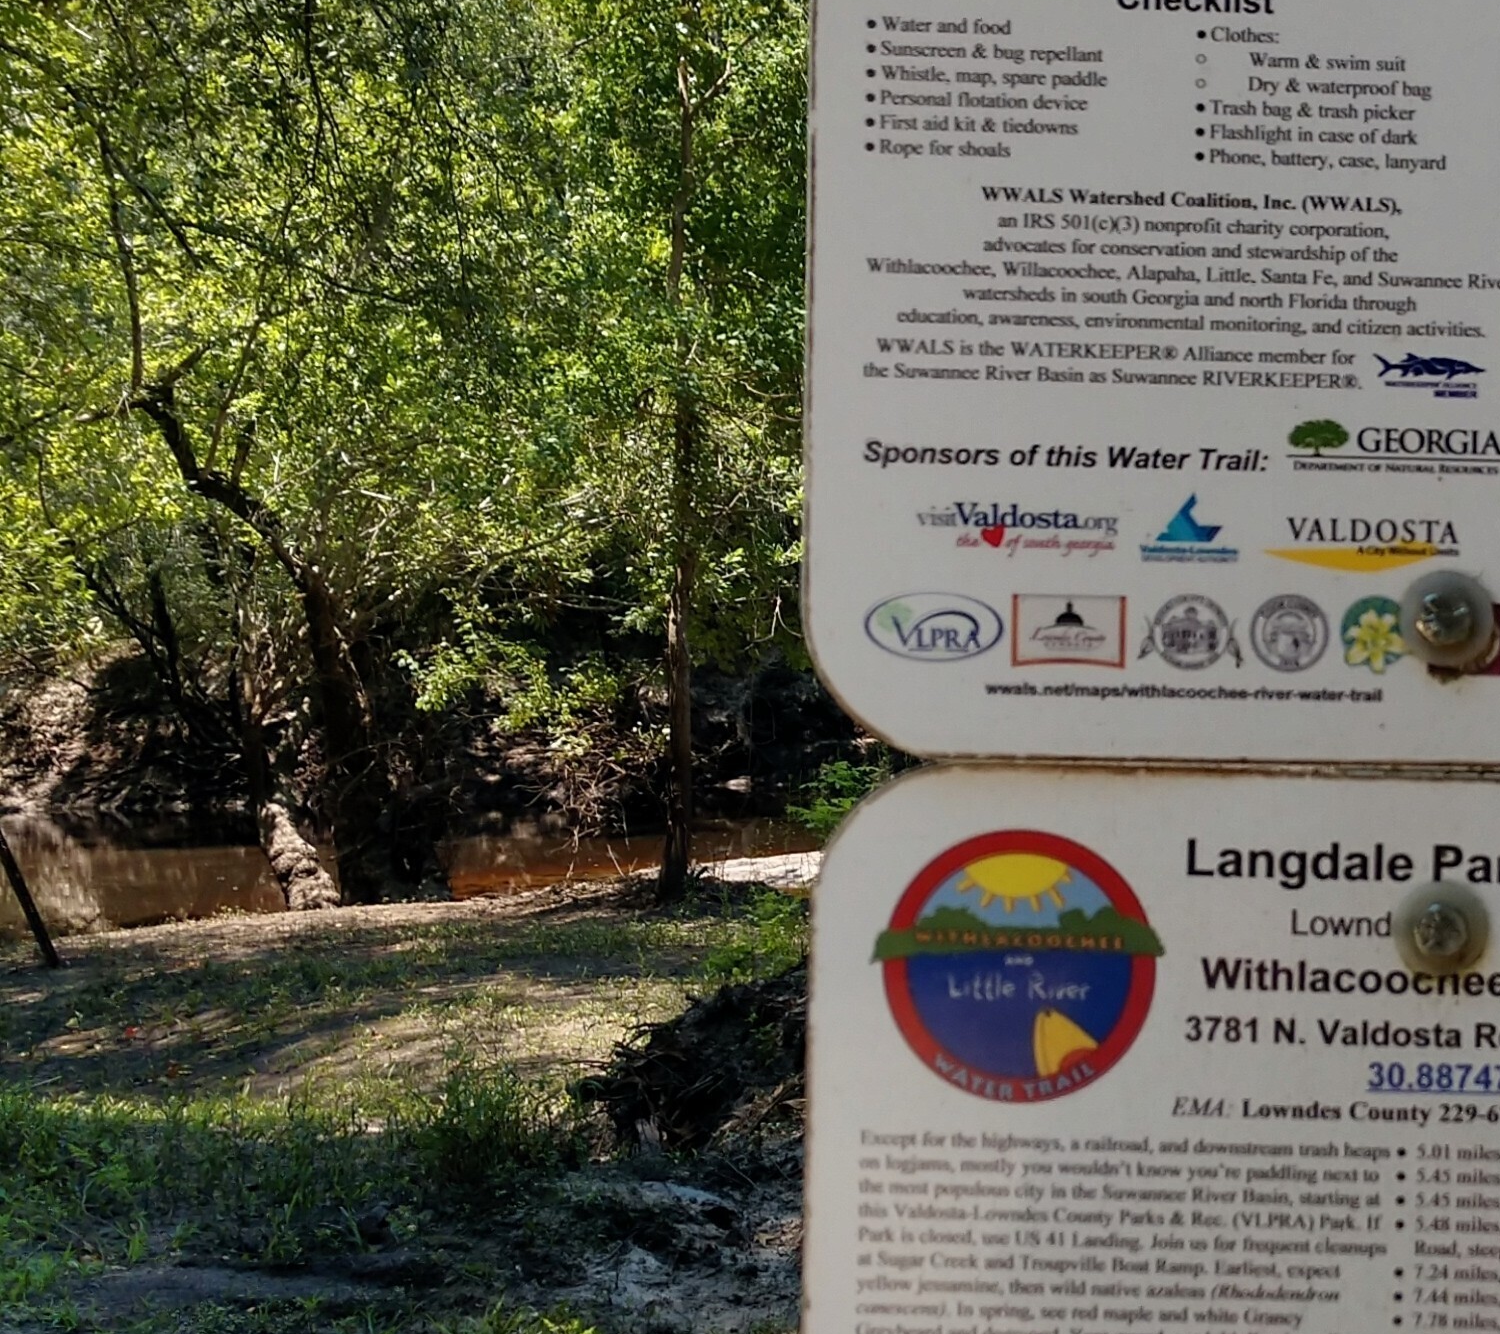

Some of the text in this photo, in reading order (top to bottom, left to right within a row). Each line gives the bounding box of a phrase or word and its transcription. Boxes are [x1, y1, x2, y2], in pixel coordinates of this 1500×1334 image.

[881, 15, 1012, 36] Water and food
[1211, 26, 1280, 44] Clothes:
[981, 186, 1403, 216] WWALS Watershed Coalition, Inc. (WWALS),
[863, 440, 1269, 472] Sponsors of this Water Trail:
[1286, 517, 1459, 545] VALDOSTA
[1186, 838, 1414, 890] Langdale
[915, 929, 1124, 950] WITHLACOOCHEE
[948, 971, 1091, 1001] Little River
[1185, 1015, 1258, 1044] 3781
[1273, 1017, 1306, 1045] N.
[1316, 1018, 1462, 1049] Valdosta
[935, 1053, 1095, 1099] WATER TRAIL
[1242, 1098, 1342, 1121] Lowndes
[1348, 1101, 1431, 1128] County
